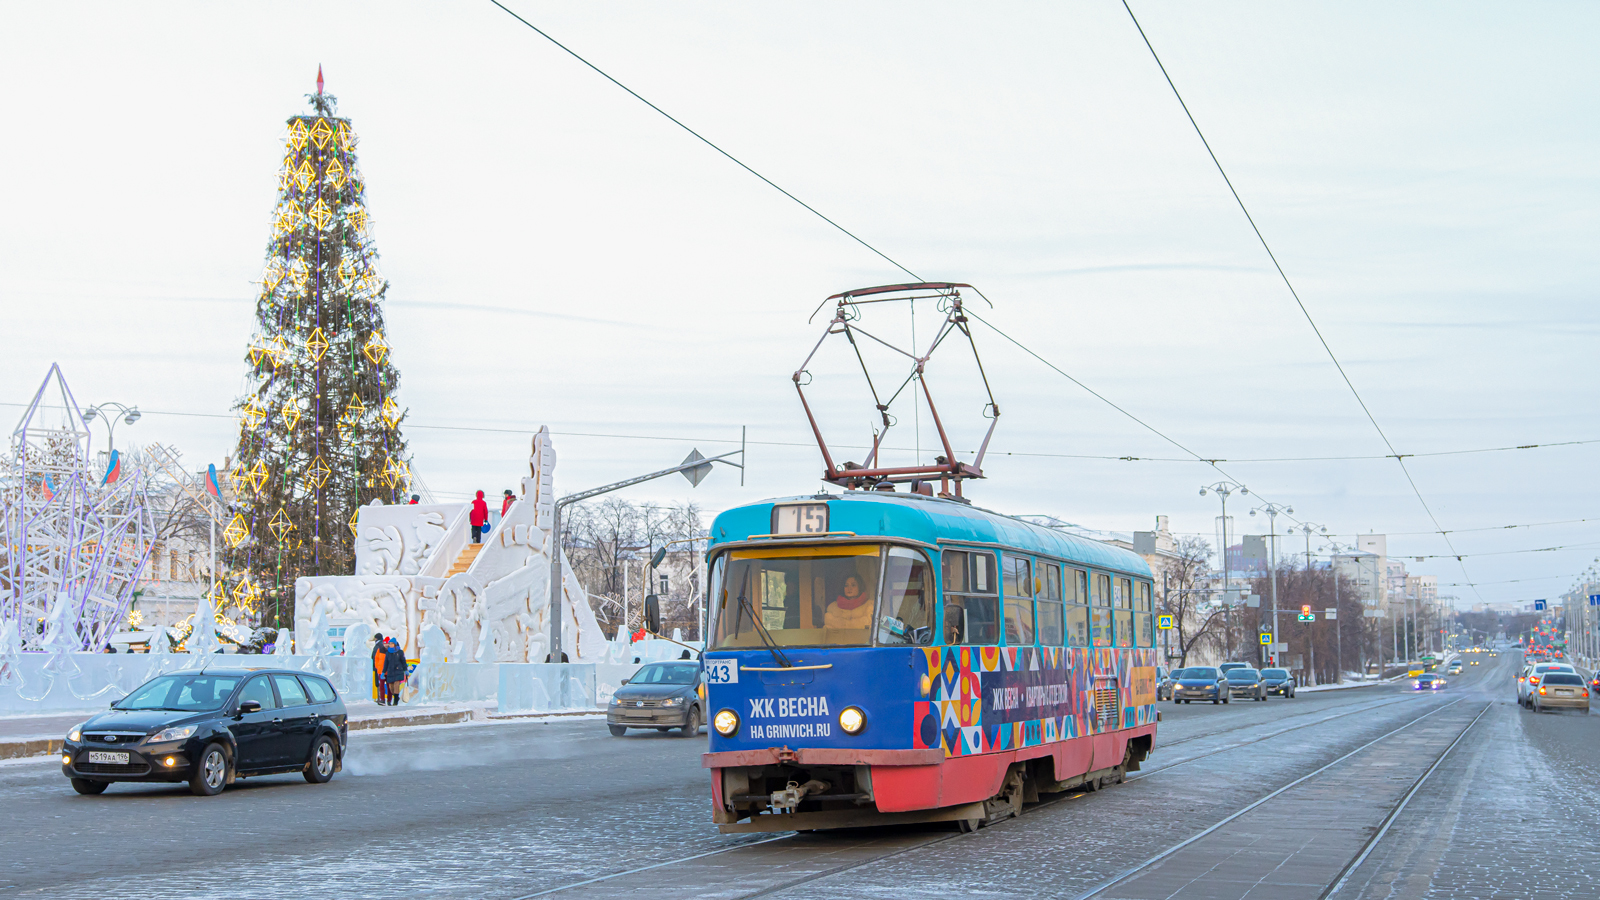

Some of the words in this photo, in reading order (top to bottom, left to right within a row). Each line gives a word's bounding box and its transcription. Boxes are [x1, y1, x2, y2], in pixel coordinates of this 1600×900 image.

[792, 506, 824, 532] 15
[749, 698, 775, 718] ЖК
[779, 696, 829, 717] ВЕСНА
[992, 688, 1004, 710] ЖК
[750, 725, 764, 738] НА
[766, 723, 831, 738] GRINVICH.RU
